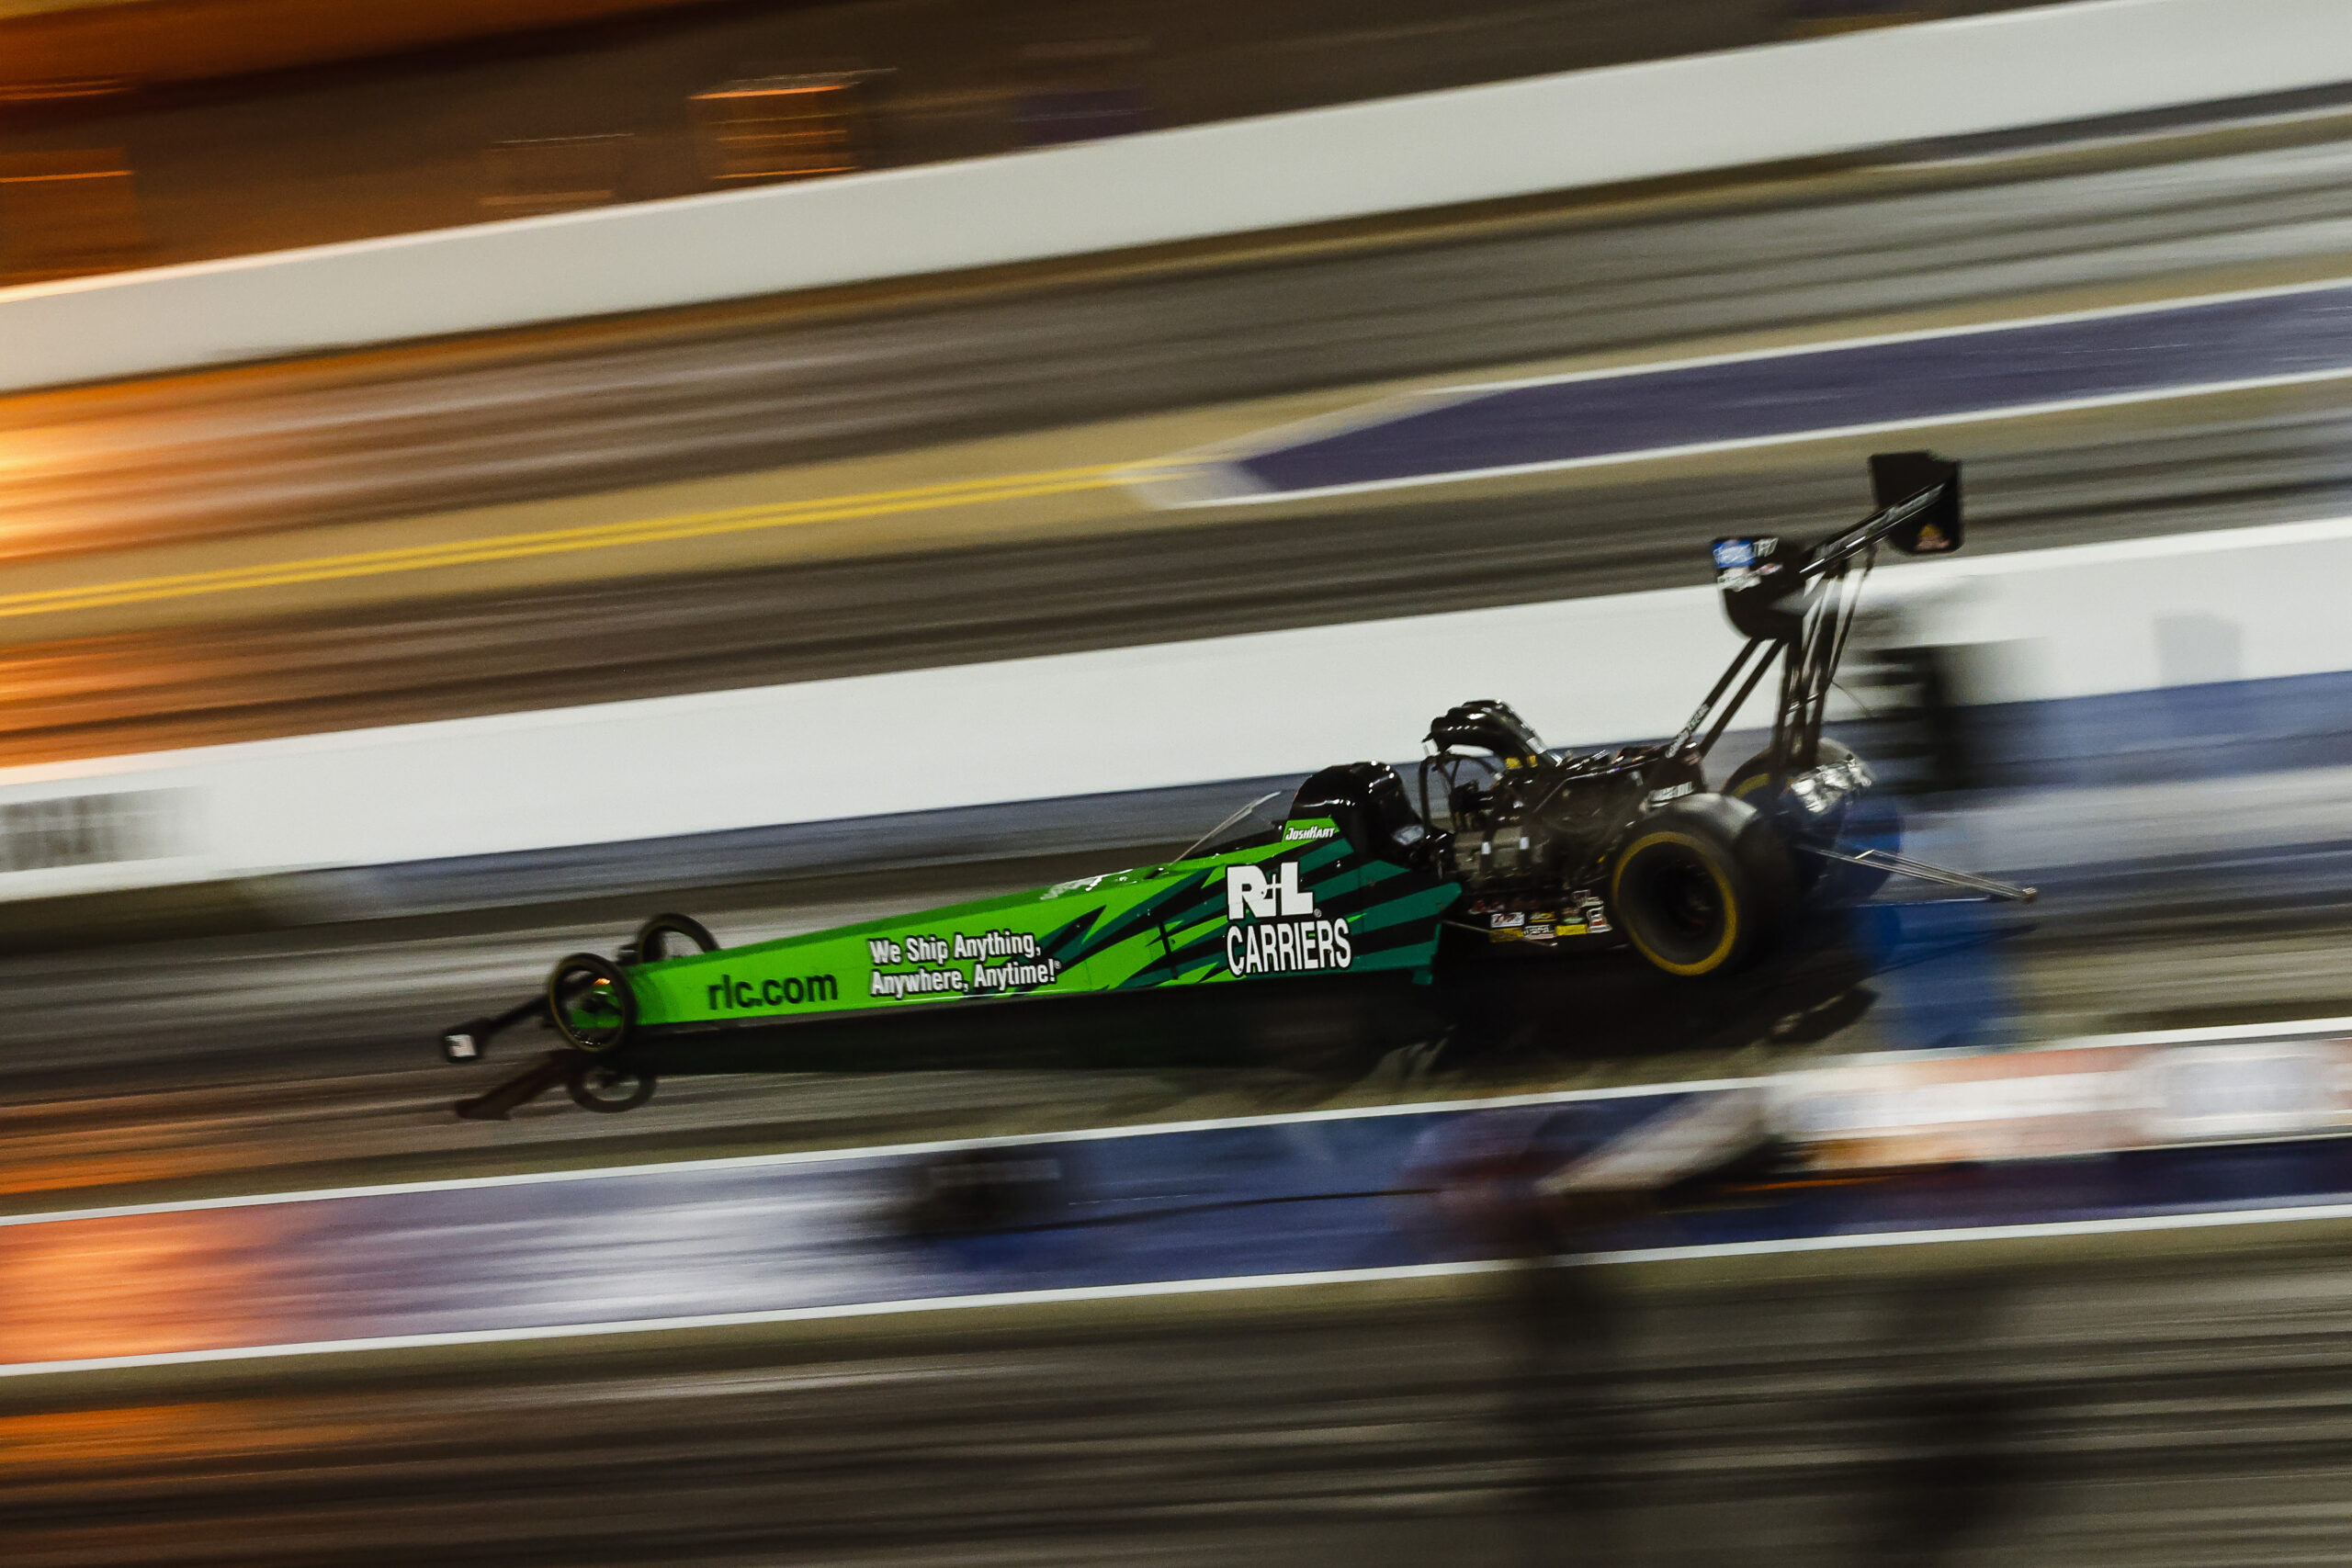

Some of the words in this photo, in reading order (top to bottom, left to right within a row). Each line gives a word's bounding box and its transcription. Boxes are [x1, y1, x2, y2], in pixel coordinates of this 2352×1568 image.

[869, 940, 902, 964] We
[906, 935, 948, 964] Ship
[954, 930, 1041, 962] Anything,
[1227, 918, 1351, 976] CARRIERS
[707, 974, 838, 1010] rlc.com
[872, 967, 969, 999] Anywhere,
